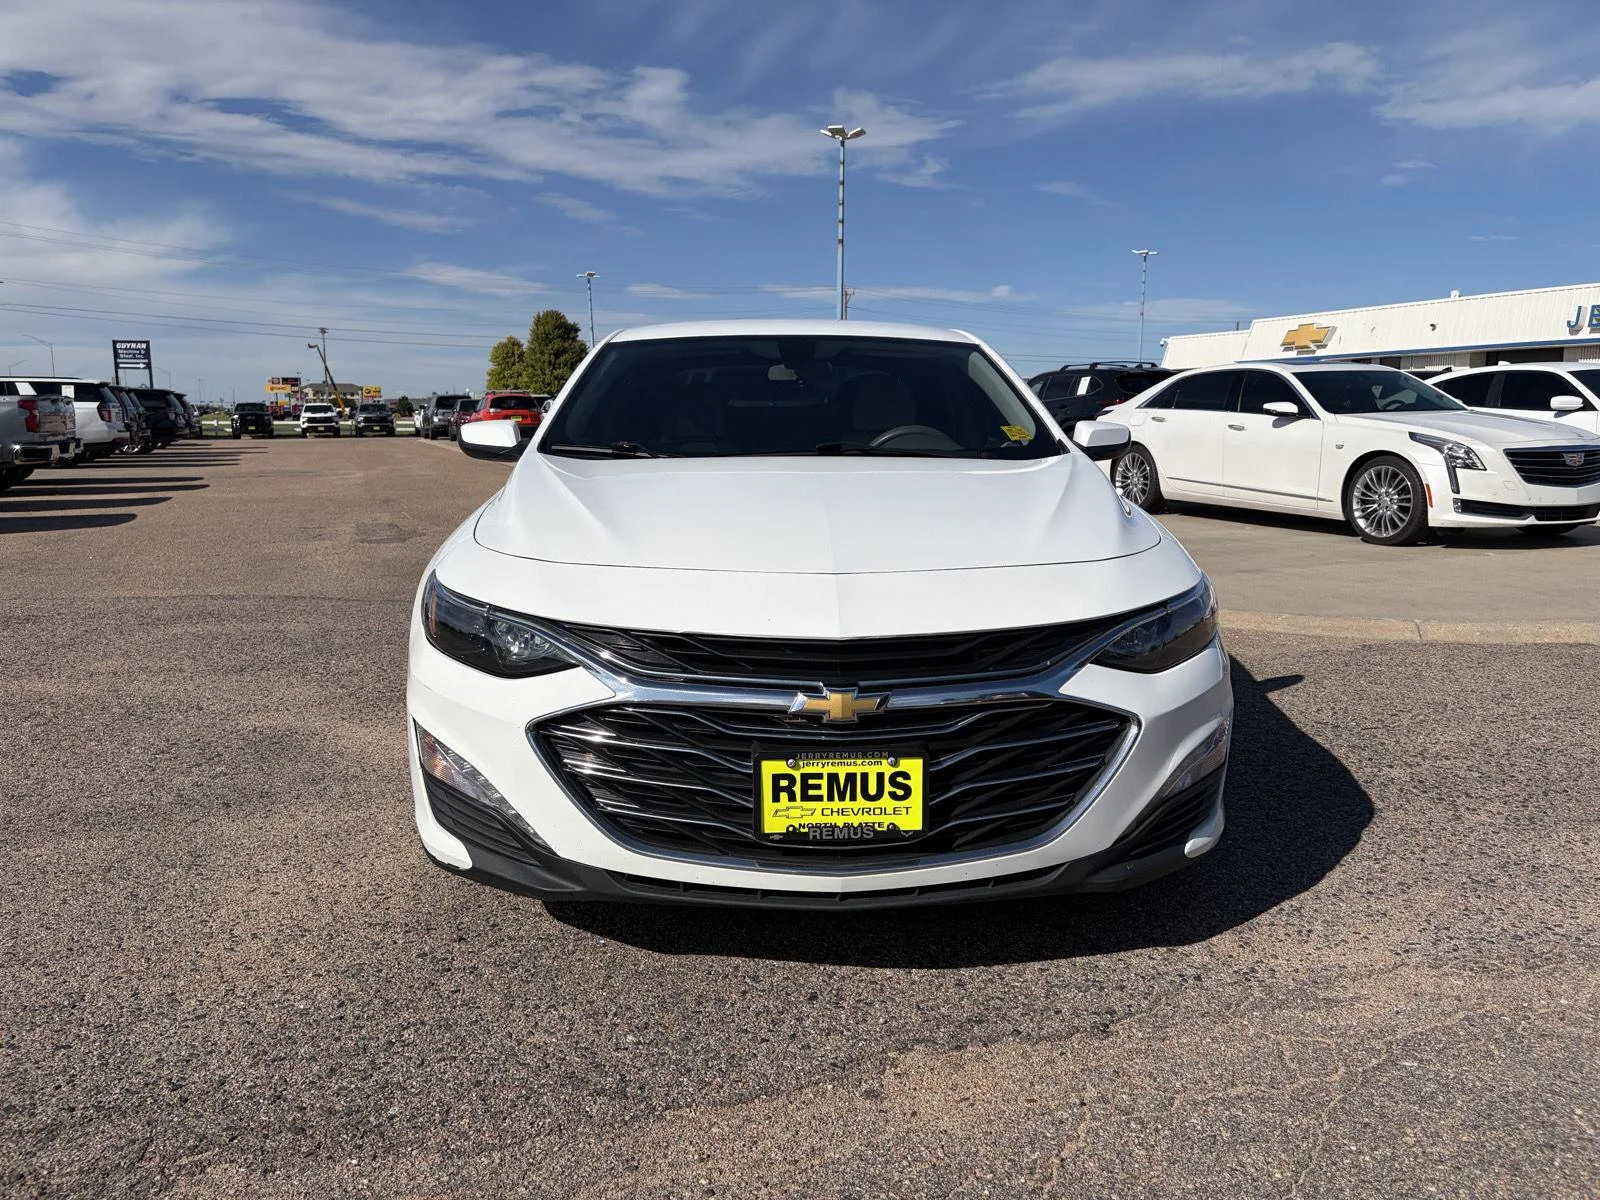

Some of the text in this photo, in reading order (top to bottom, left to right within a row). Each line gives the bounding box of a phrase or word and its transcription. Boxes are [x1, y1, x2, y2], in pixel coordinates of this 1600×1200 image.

[795, 752, 889, 760] JERRYREMUS.COM
[801, 759, 883, 769] jerryremus.com
[771, 771, 913, 803] REMUS
[821, 806, 912, 817] CHEVROLET
[809, 827, 875, 840] REMUS
